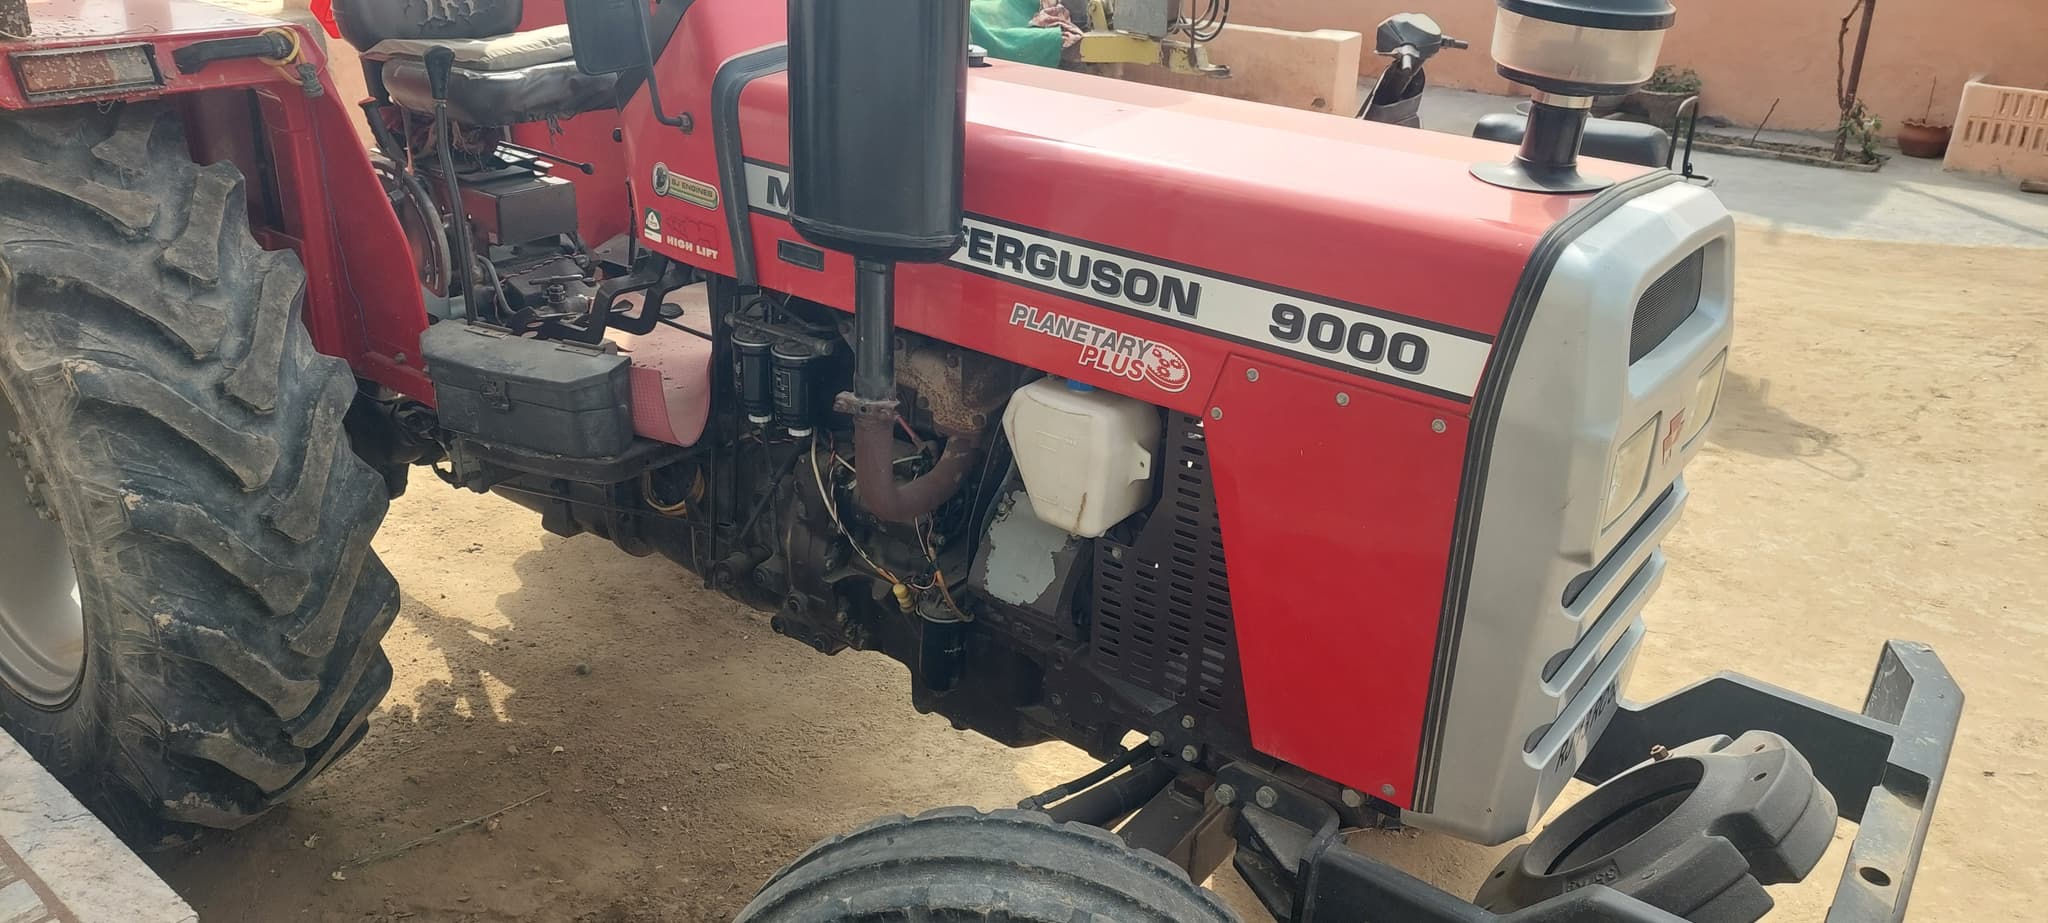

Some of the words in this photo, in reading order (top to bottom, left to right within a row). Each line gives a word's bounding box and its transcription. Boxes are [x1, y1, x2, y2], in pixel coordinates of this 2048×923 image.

[667, 235, 693, 252] HIGH
[696, 245, 718, 260] LIFT
[962, 225, 1202, 319] ERGUSON
[1268, 302, 1430, 375] 9000
[1009, 302, 1154, 361] PLANETARY
[1078, 345, 1146, 382] PLUS
